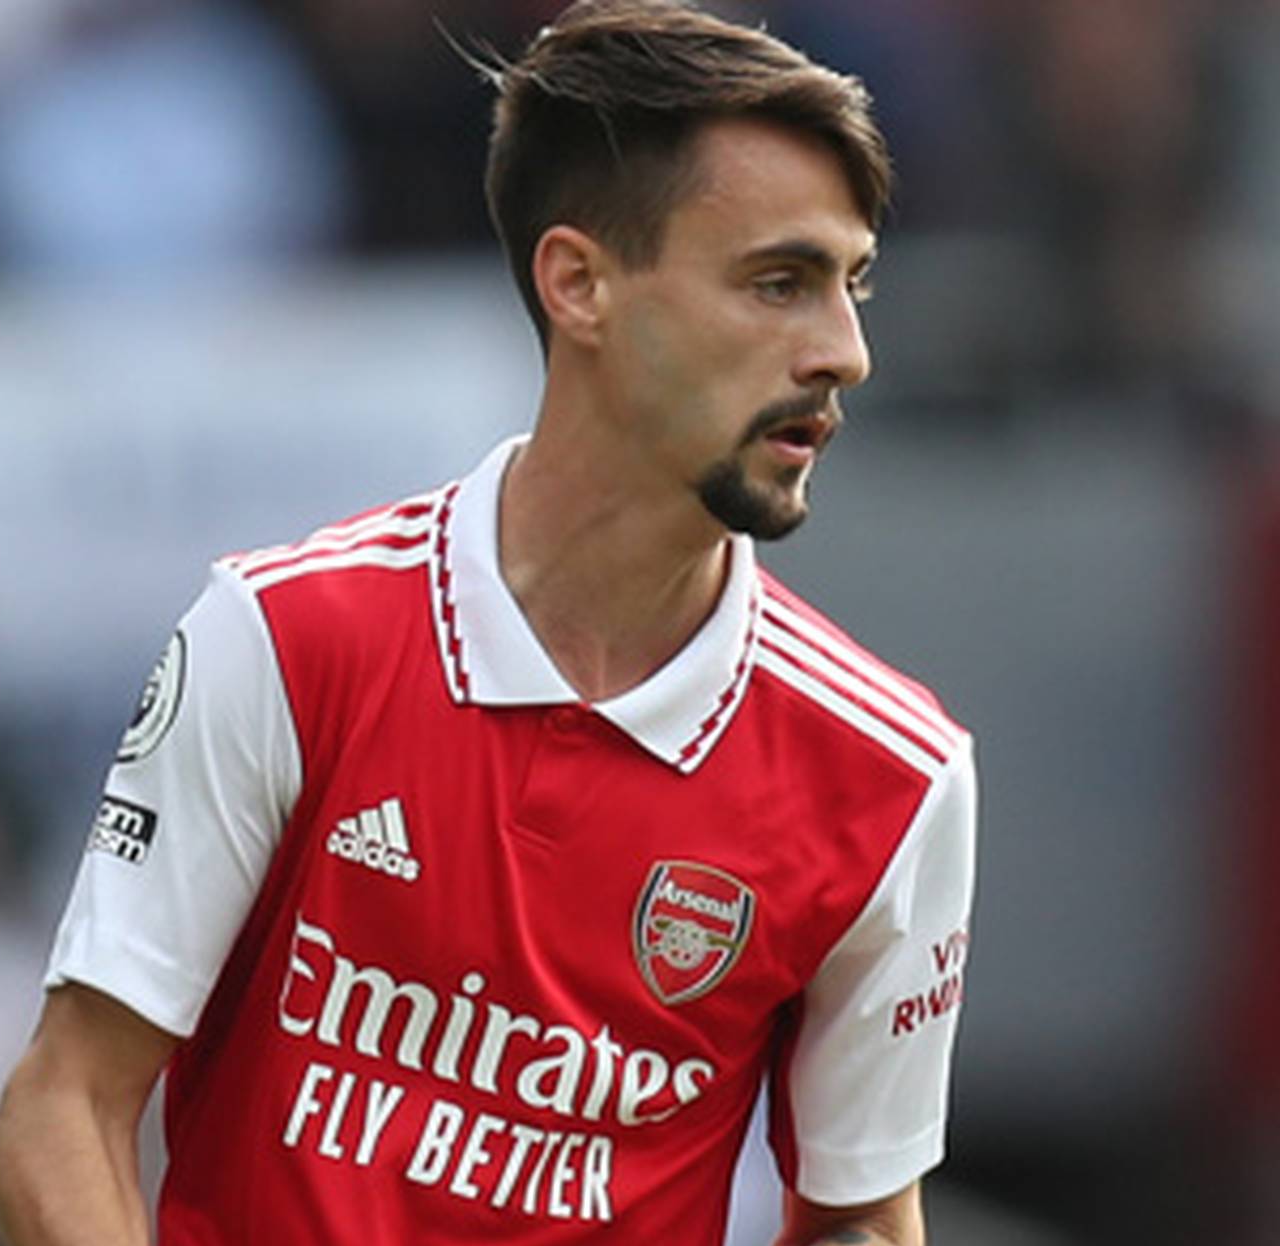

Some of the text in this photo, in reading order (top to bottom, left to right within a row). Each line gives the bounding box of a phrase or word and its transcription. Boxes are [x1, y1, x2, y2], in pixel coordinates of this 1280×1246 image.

[326, 831, 421, 882] adidas
[658, 880, 739, 922] Arsenal
[278, 908, 715, 1127] Emirates
[282, 1061, 614, 1223] FLY BETTER
